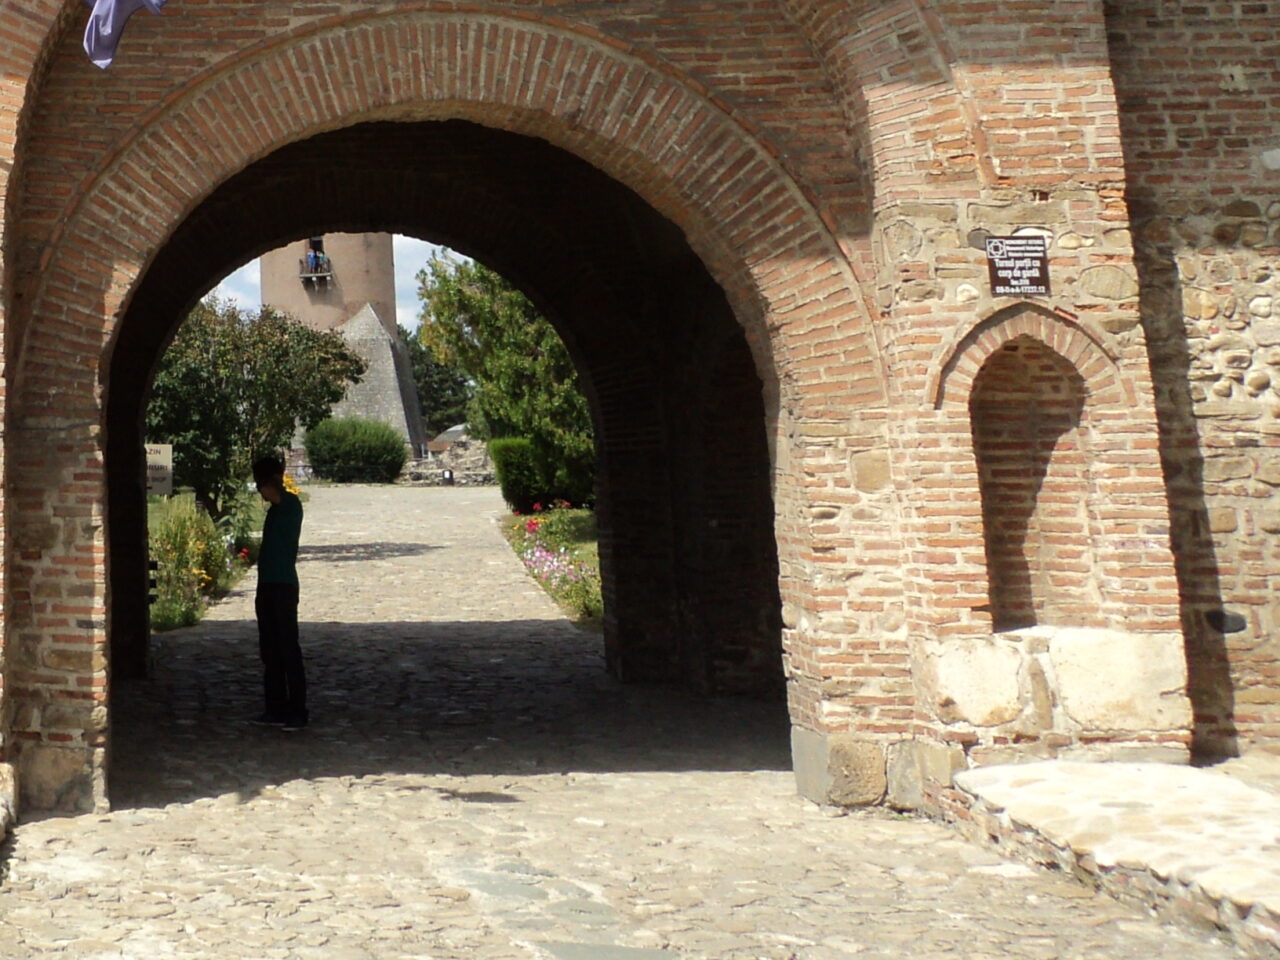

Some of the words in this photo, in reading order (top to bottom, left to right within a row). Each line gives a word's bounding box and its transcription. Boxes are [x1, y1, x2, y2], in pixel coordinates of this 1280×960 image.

[994, 258, 1015, 267] Turnul
[997, 270, 1012, 279] corp
[1013, 268, 1021, 277] de
